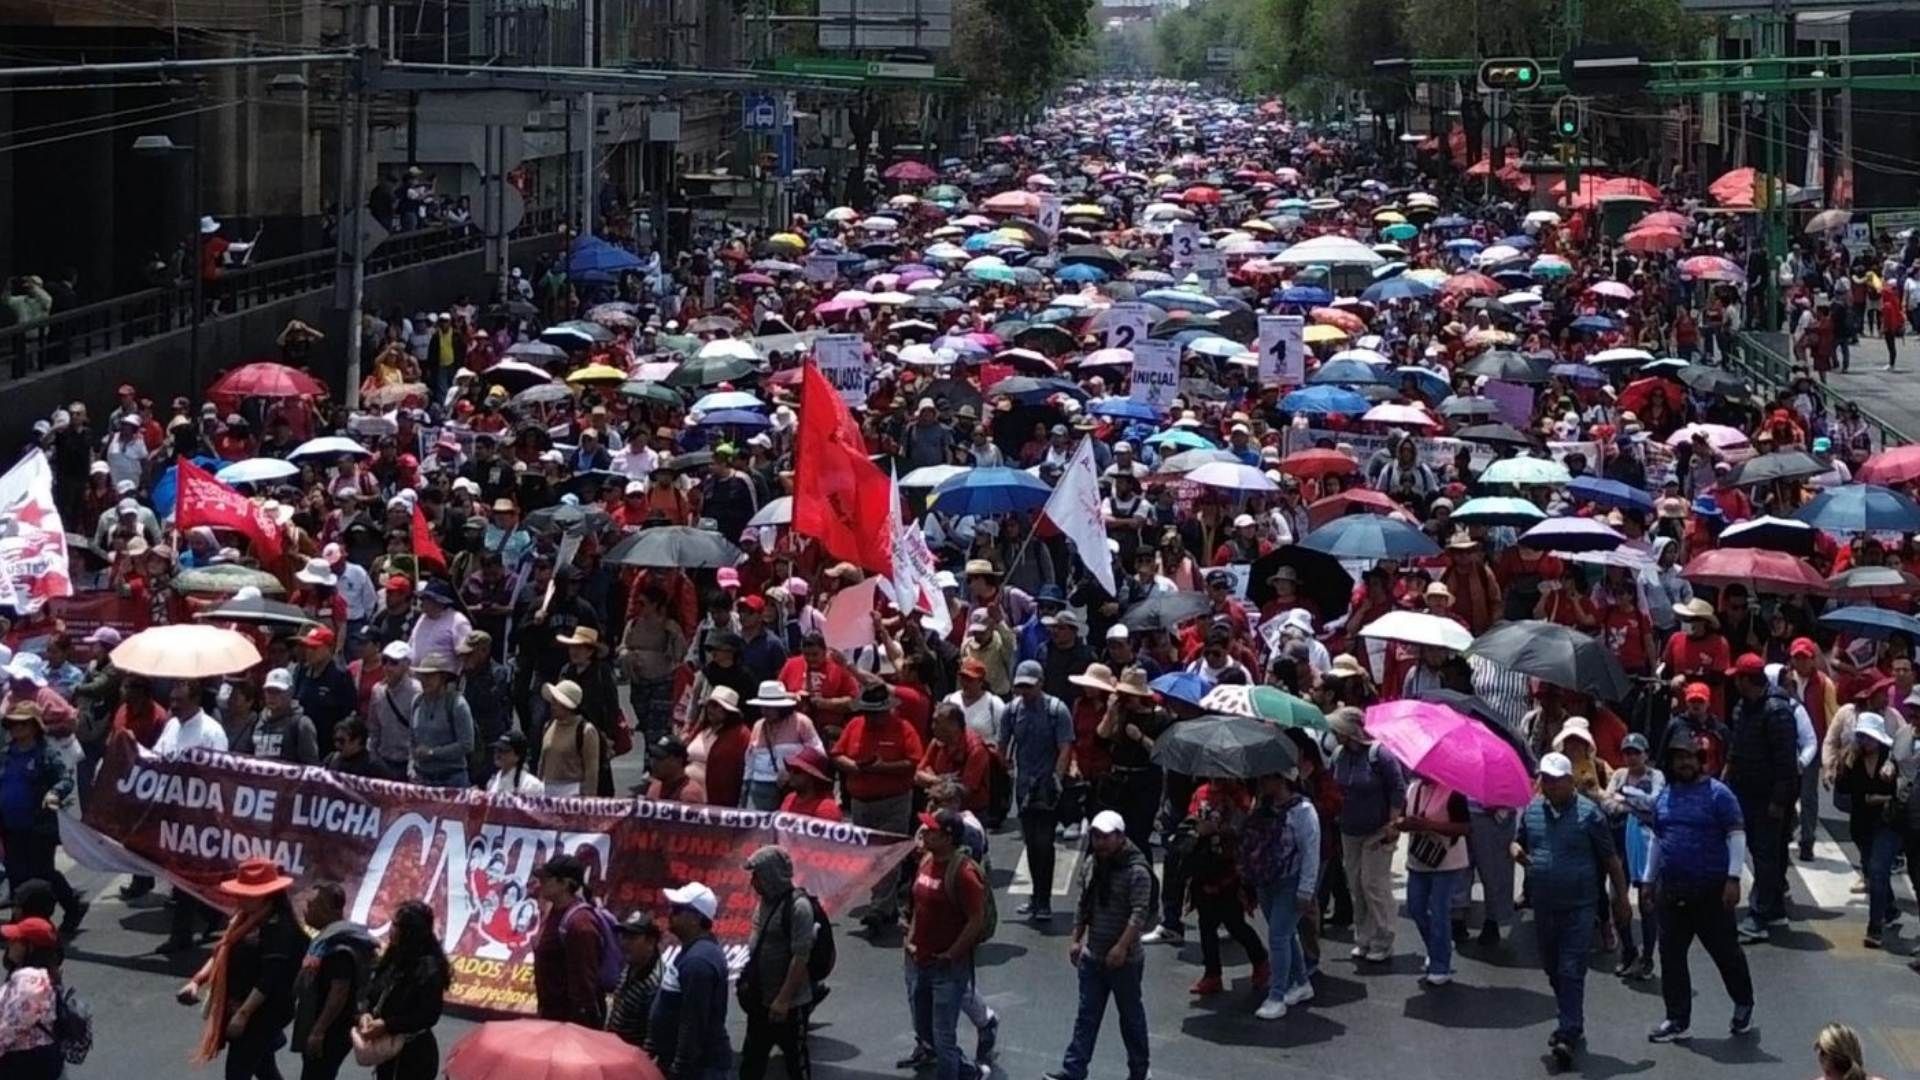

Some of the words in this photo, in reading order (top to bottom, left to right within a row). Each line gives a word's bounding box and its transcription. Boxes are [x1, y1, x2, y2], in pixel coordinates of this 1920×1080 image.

[1042, 211, 1053, 228] 4
[1179, 237, 1192, 256] 3
[1115, 325, 1135, 349] 2
[1269, 340, 1287, 361] 1
[1133, 371, 1176, 386] INICIAL
[232, 785, 277, 822] DE
[291, 793, 382, 839] LUCHA
[637, 799, 672, 821] DE
[678, 805, 713, 825] LA
[719, 809, 872, 847] EDUCACION
[160, 819, 305, 875] NACIONAL
